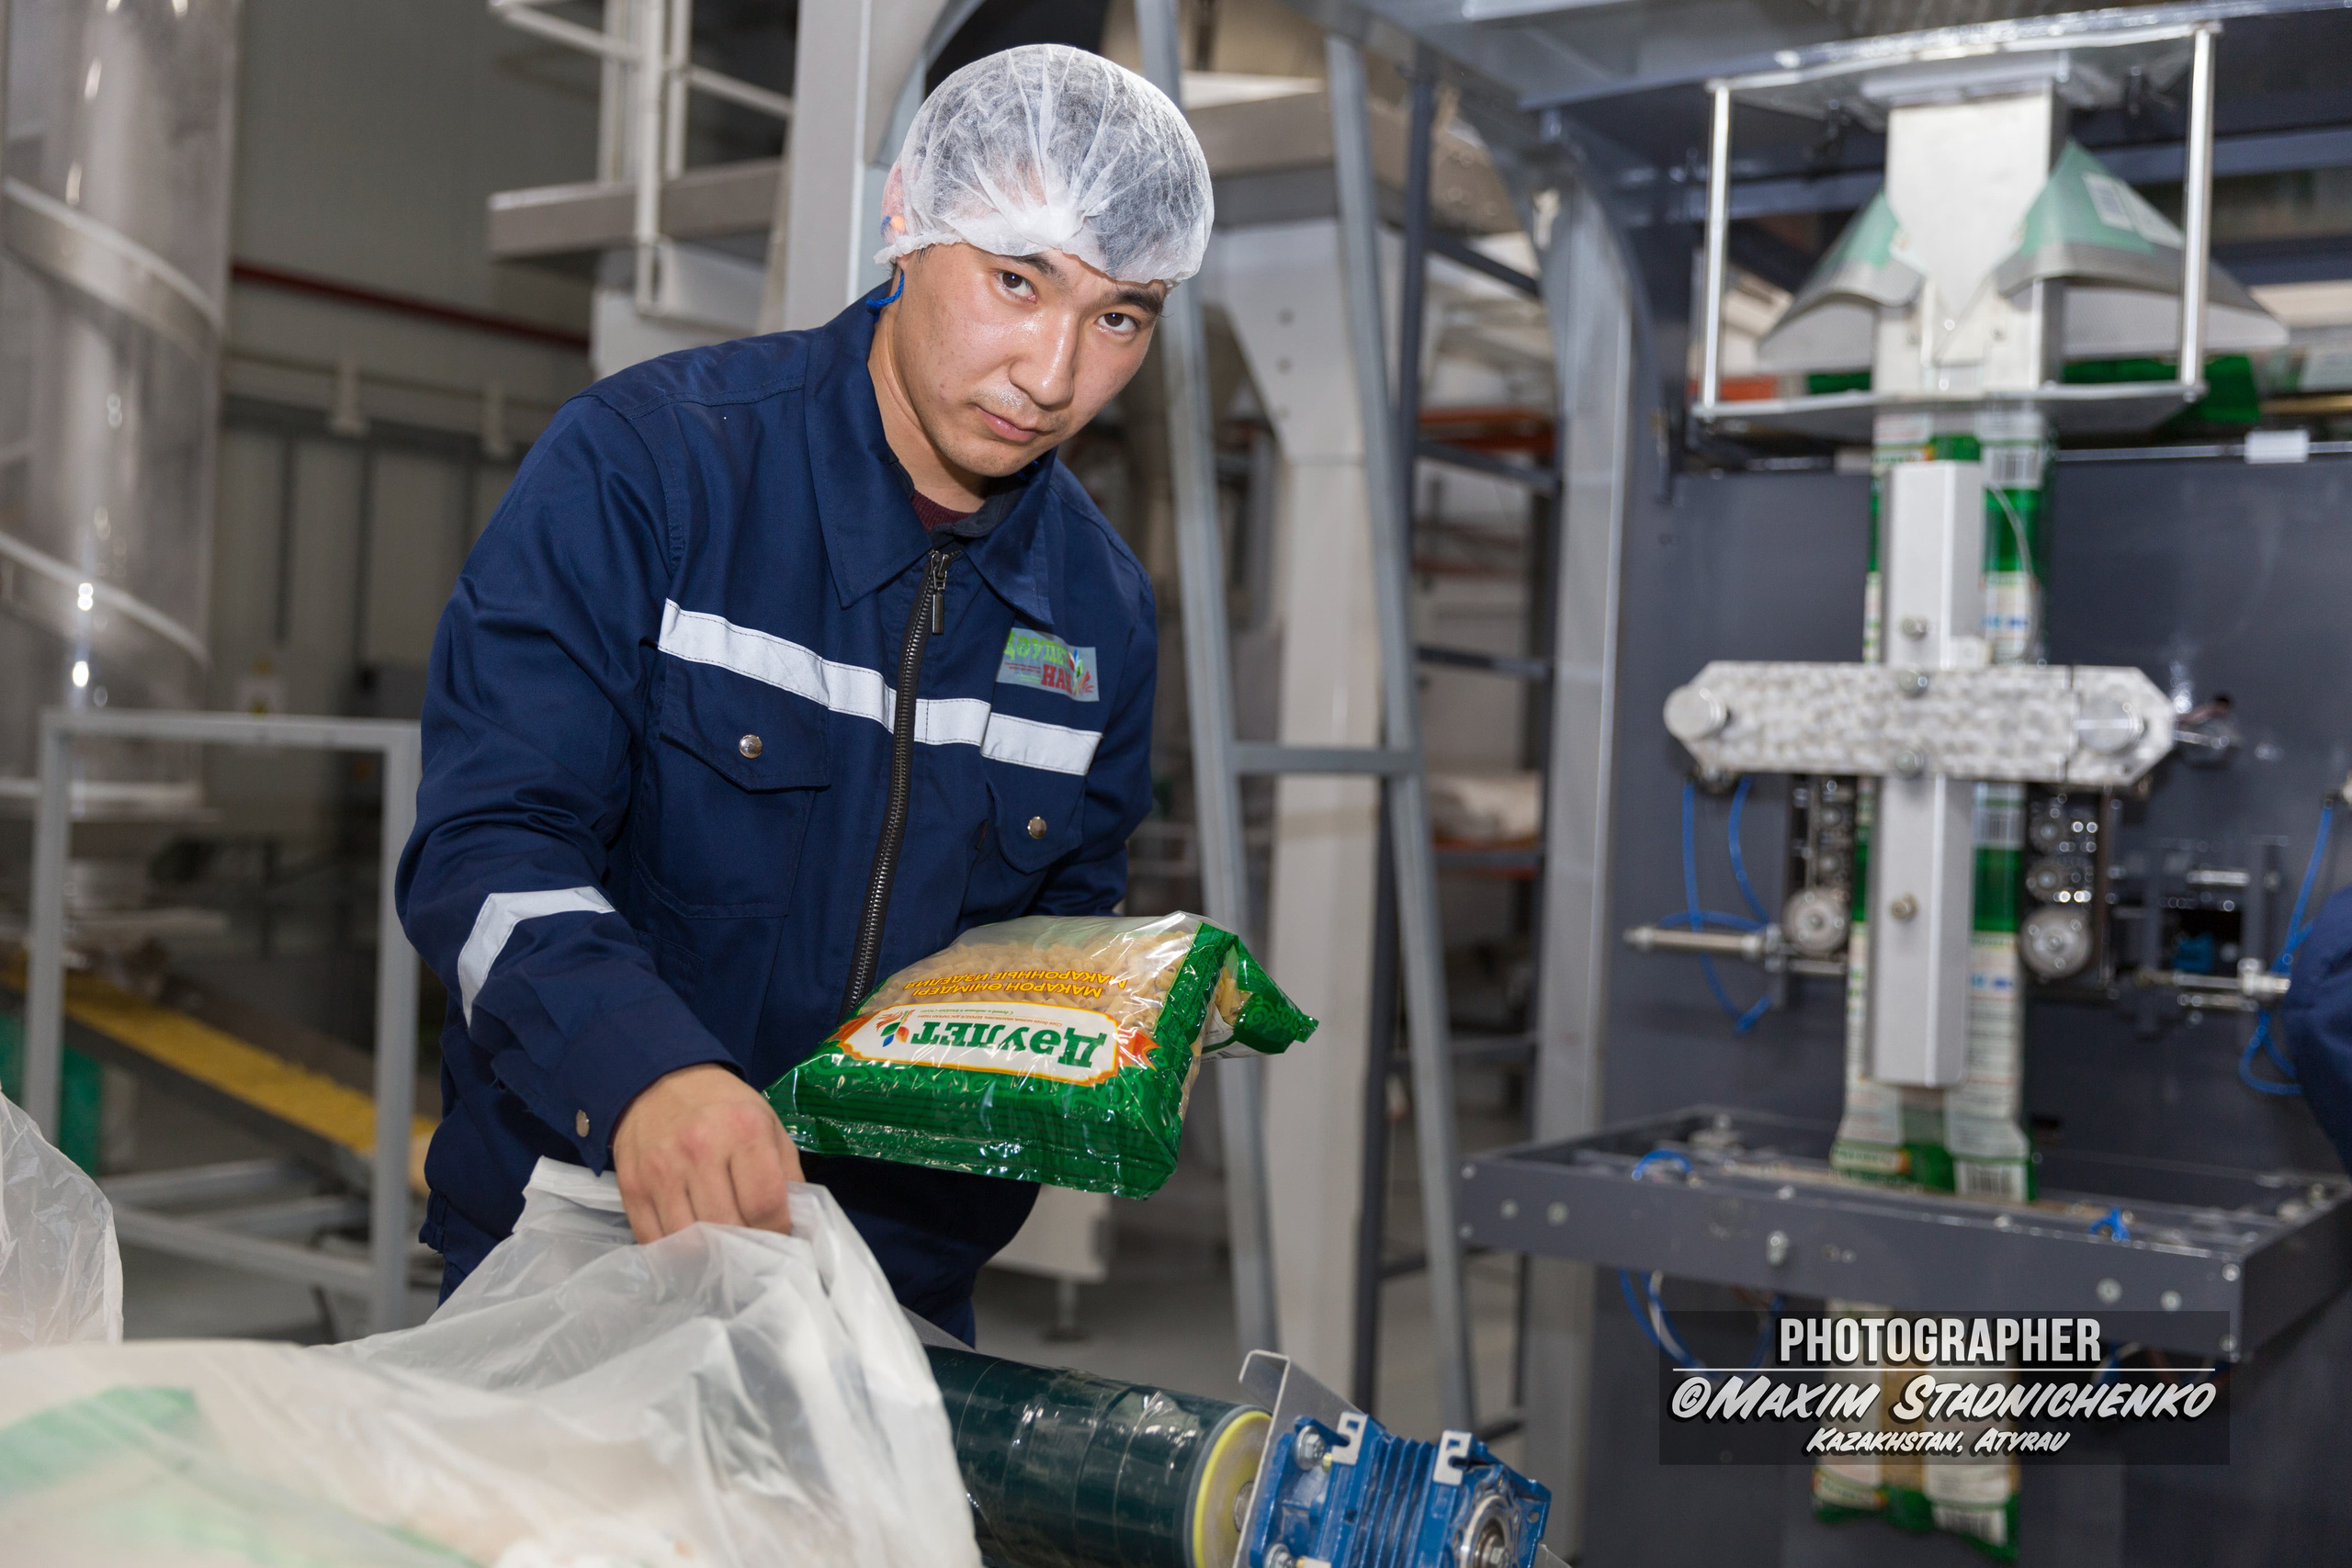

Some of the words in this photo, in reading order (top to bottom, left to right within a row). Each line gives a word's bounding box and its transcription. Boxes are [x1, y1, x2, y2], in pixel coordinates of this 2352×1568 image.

[903, 973, 990, 990] ИЗДЕЛИЯ
[991, 969, 1127, 989] МАКАРОННЫЕ
[910, 982, 1003, 998] ӨНІМДЕРІ
[1005, 982, 1102, 998] МАКАРОН
